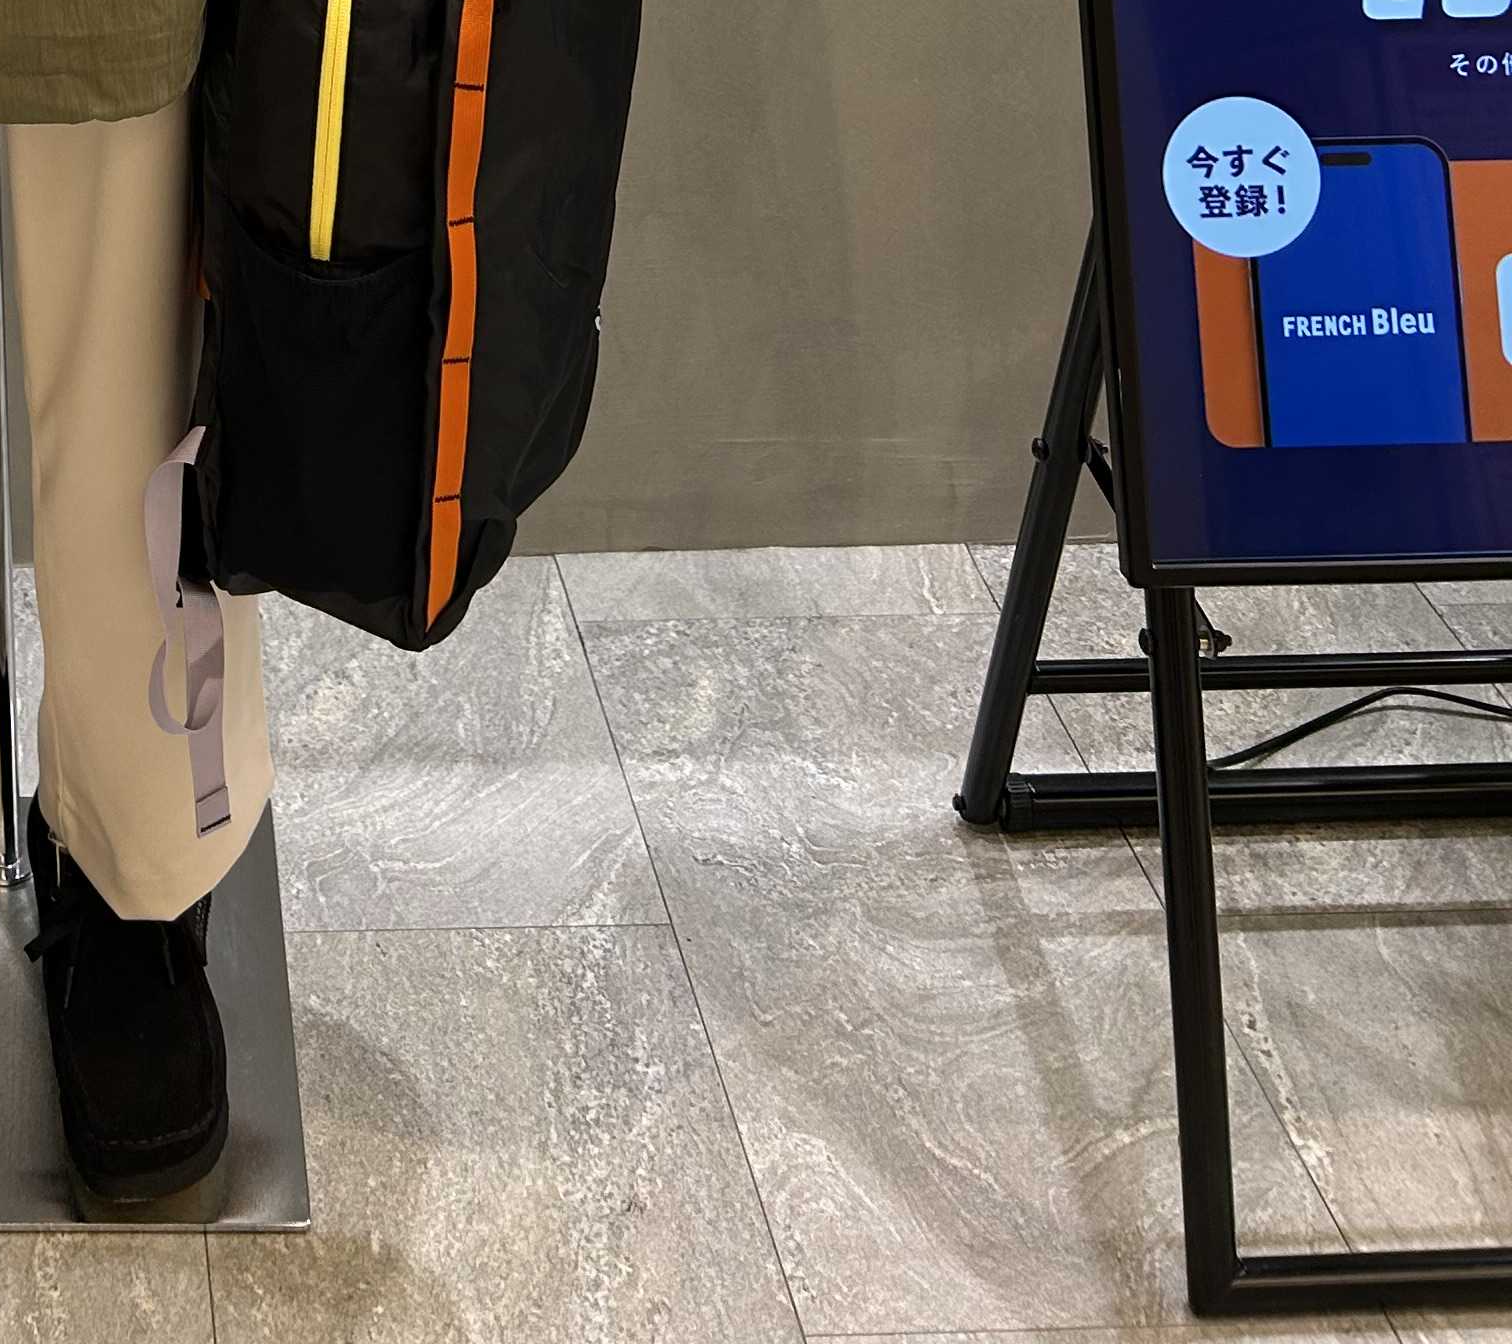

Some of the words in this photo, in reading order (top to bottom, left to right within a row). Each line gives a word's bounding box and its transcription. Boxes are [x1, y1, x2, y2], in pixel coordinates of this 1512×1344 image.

[1186, 144, 1290, 179] 今すぐ
[1283, 314, 1367, 338] FRENCH
[1371, 307, 1435, 335] Bleu
